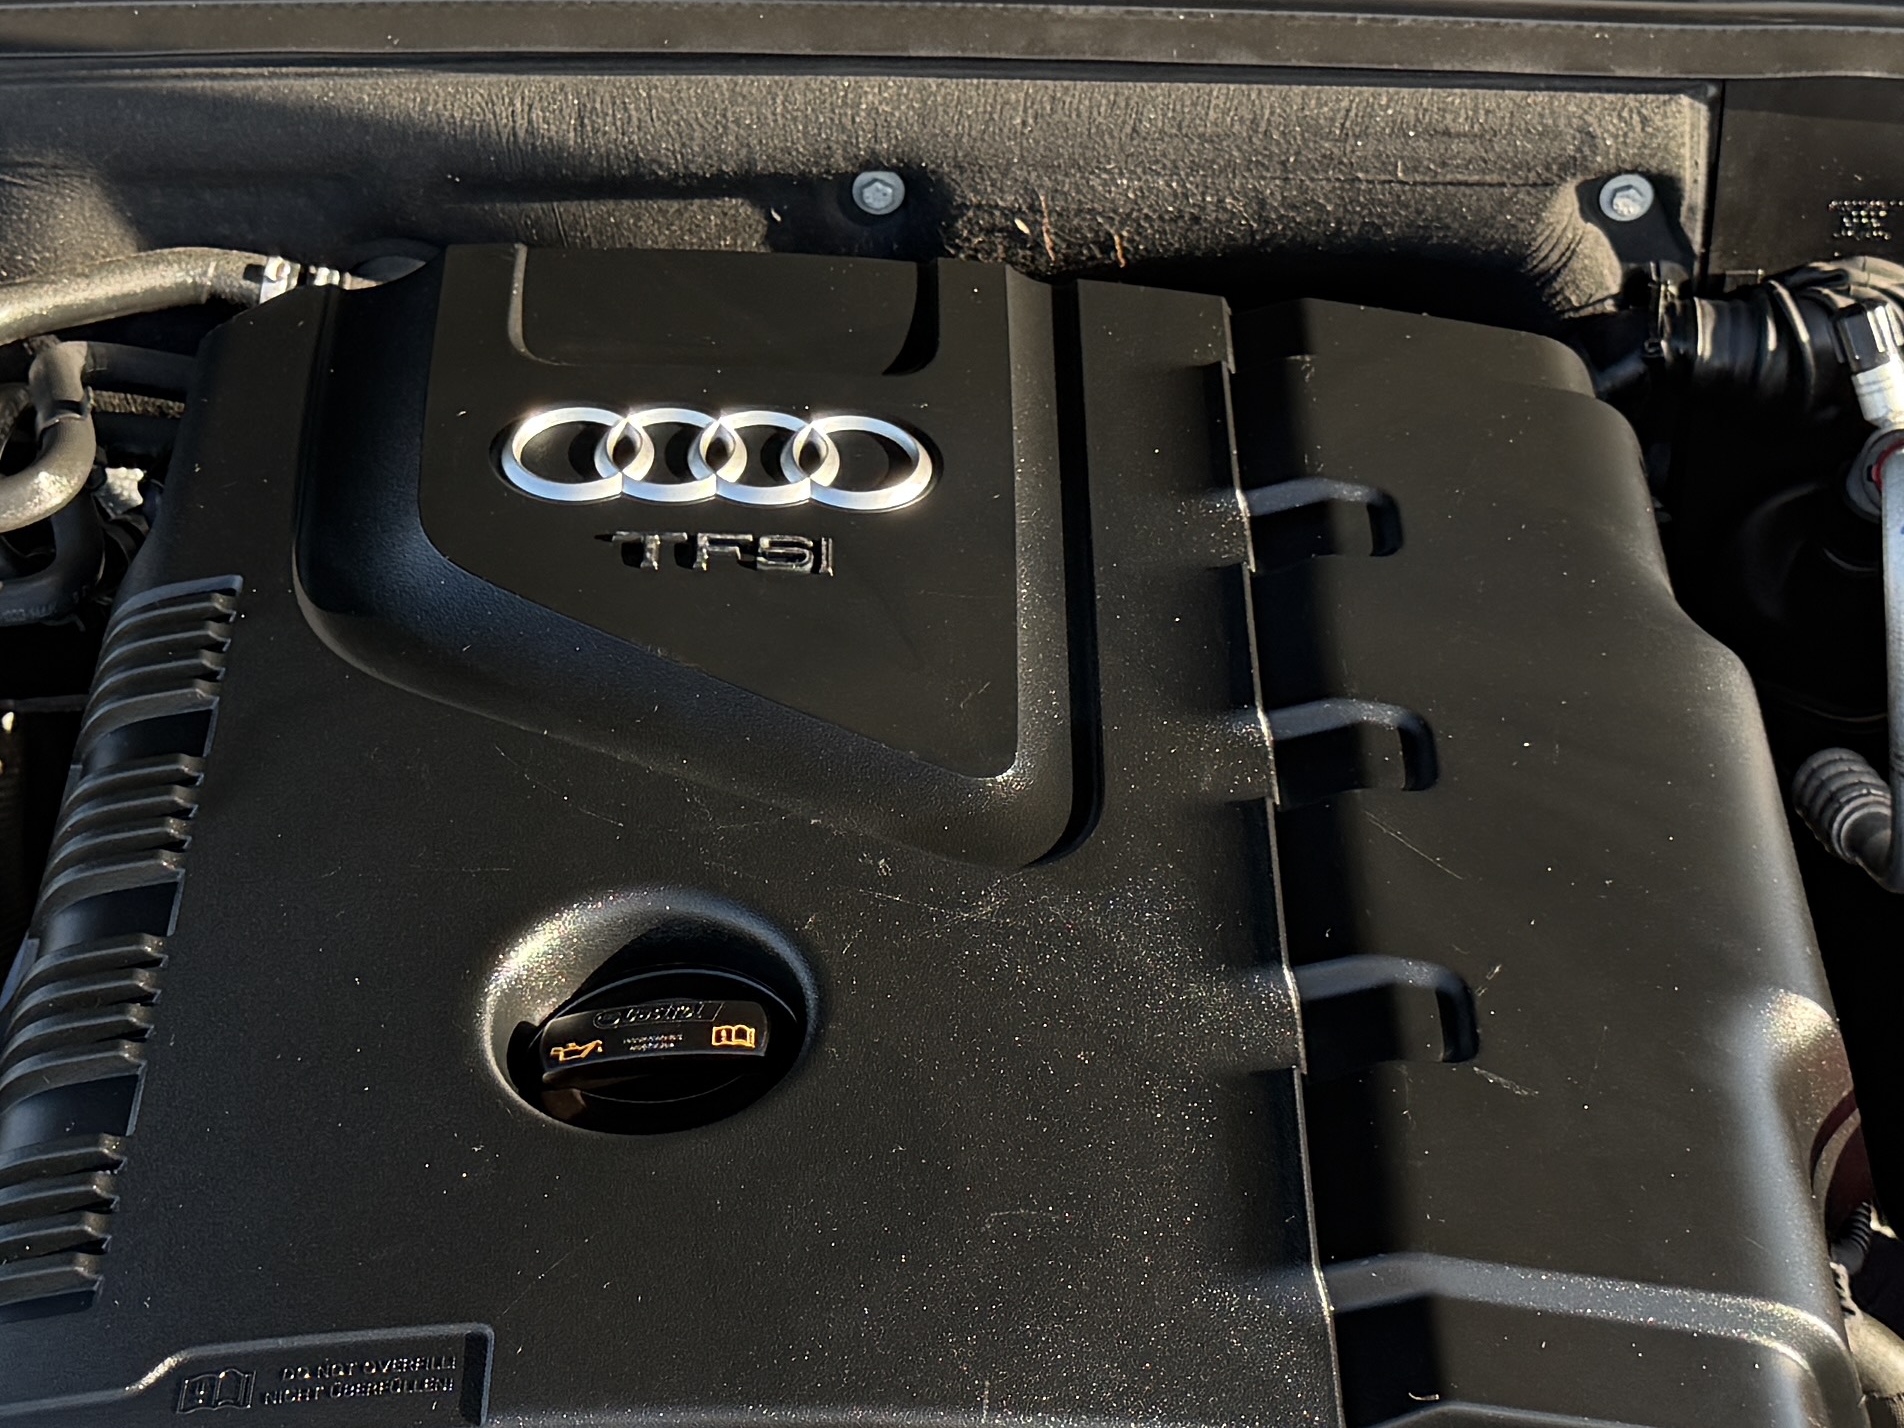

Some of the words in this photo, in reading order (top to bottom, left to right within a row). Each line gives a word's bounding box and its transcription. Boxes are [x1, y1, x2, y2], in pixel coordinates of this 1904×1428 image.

[611, 531, 834, 577] TFSI
[282, 1366, 310, 1381] DO
[317, 1361, 358, 1379] NOT
[362, 1355, 457, 1375] OVERFILL!
[263, 1385, 325, 1405] NICHT
[329, 1376, 455, 1398] ÜBERFÜLLEN!
